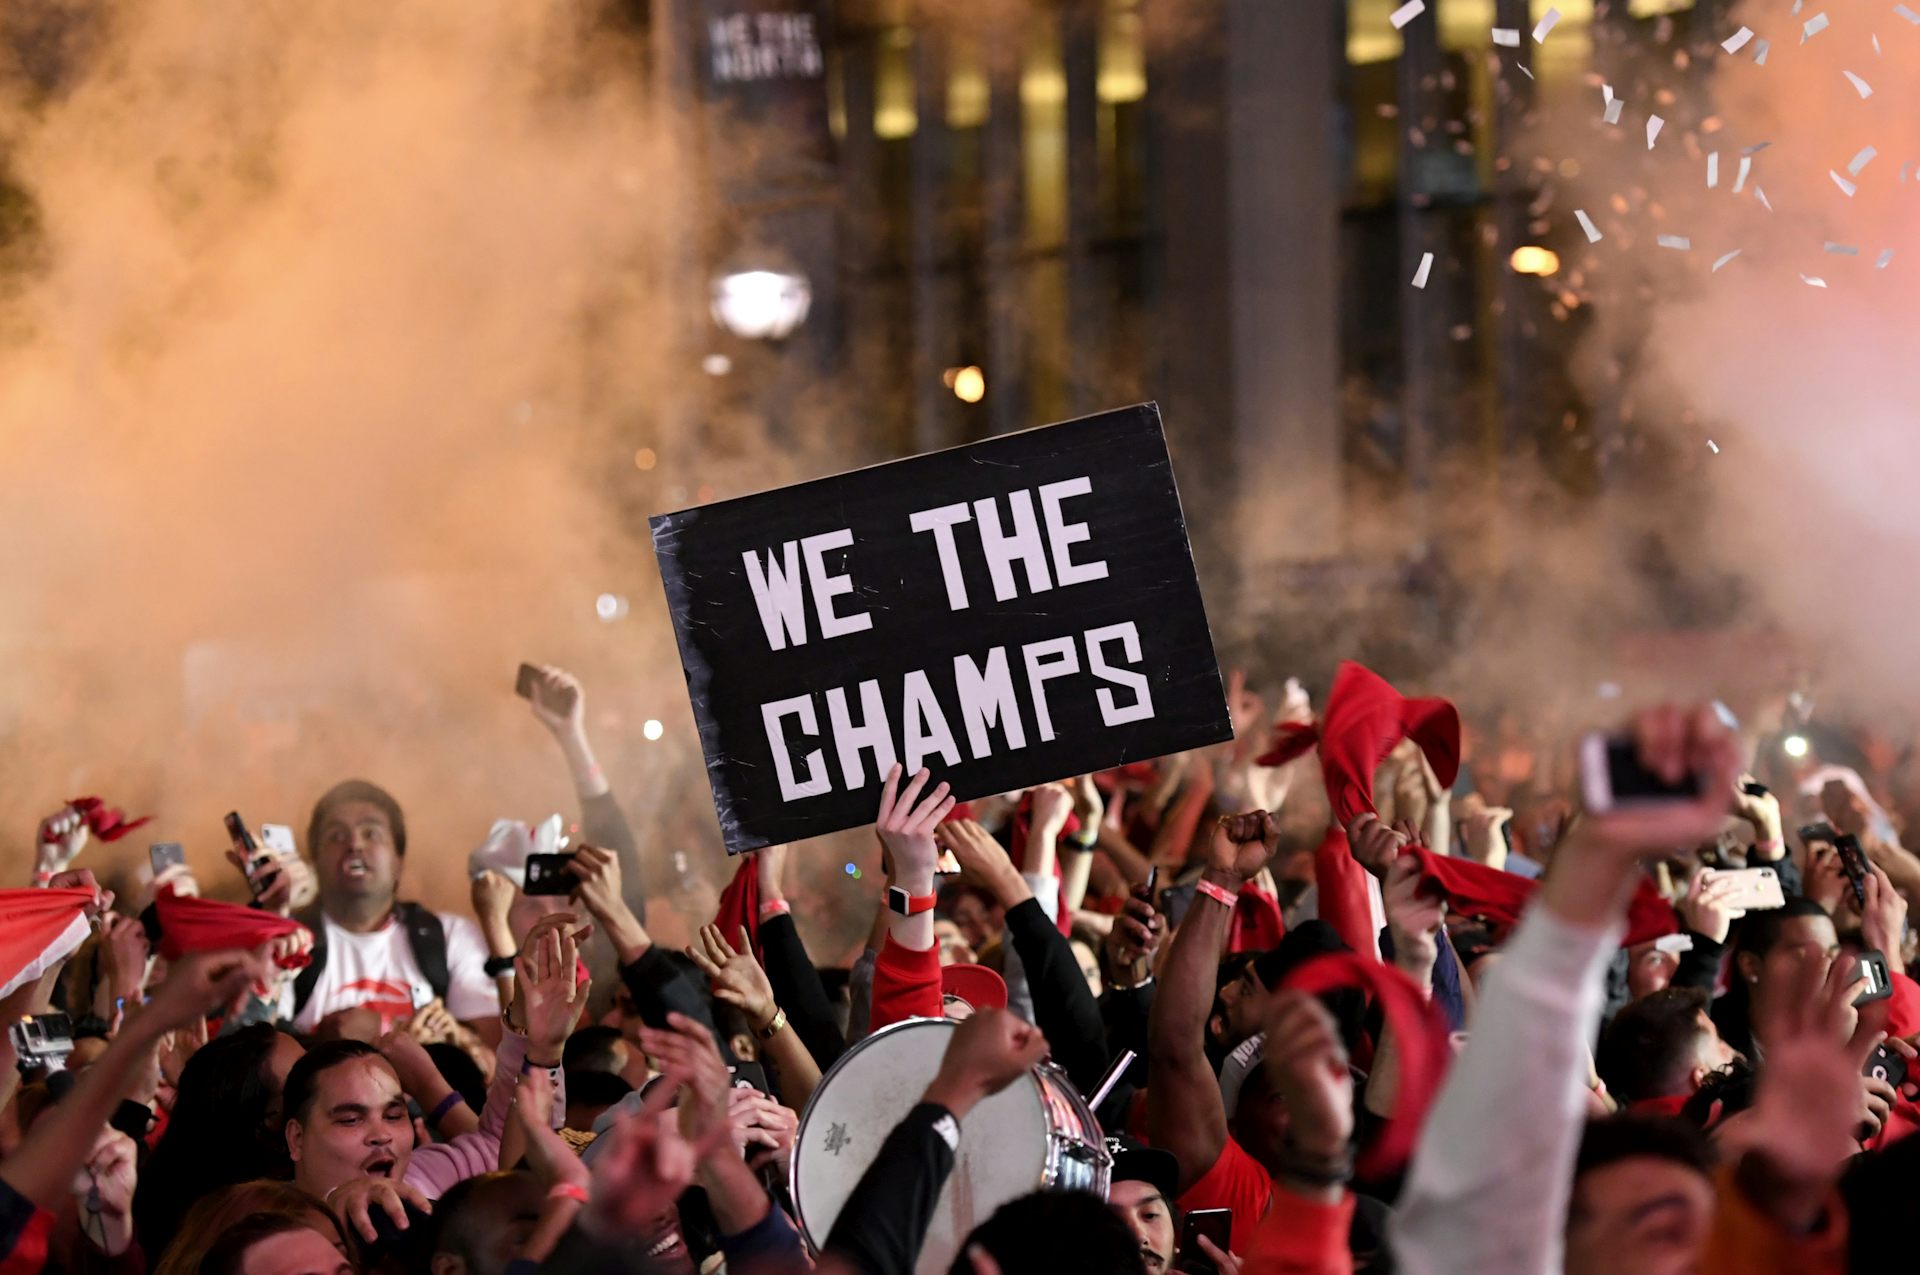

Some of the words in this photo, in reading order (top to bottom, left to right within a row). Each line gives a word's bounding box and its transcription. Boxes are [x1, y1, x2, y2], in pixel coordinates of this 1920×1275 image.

[742, 529, 873, 651] WE
[909, 476, 1109, 611] THE
[760, 621, 1155, 802] CHAMPS
